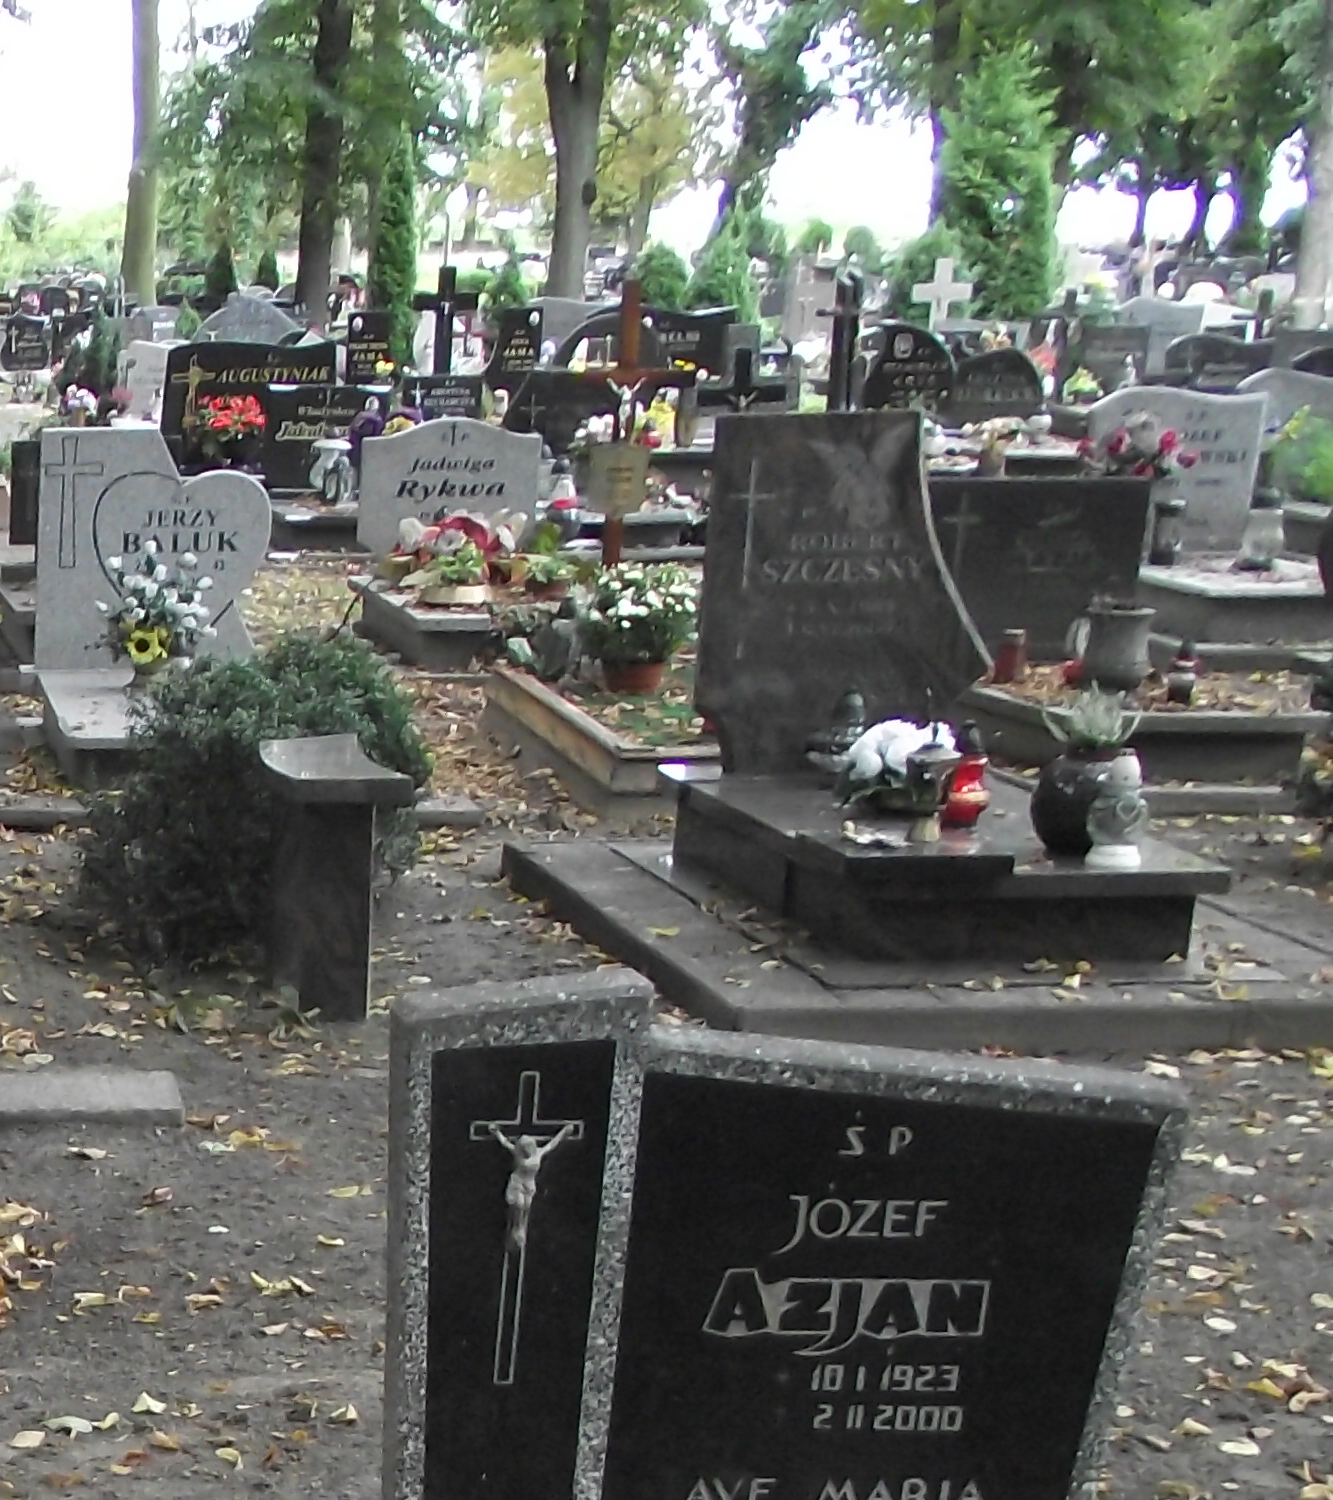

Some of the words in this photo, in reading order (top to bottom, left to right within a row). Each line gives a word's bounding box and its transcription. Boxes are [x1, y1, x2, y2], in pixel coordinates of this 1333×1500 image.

[216, 366, 330, 383] AUGUSTYNIAK
[406, 457, 496, 474] Jadwiga
[395, 478, 506, 501] Rykwa
[143, 508, 220, 528] JERZY
[123, 531, 239, 554] BALUK
[702, 1268, 991, 1357] AZJAN
